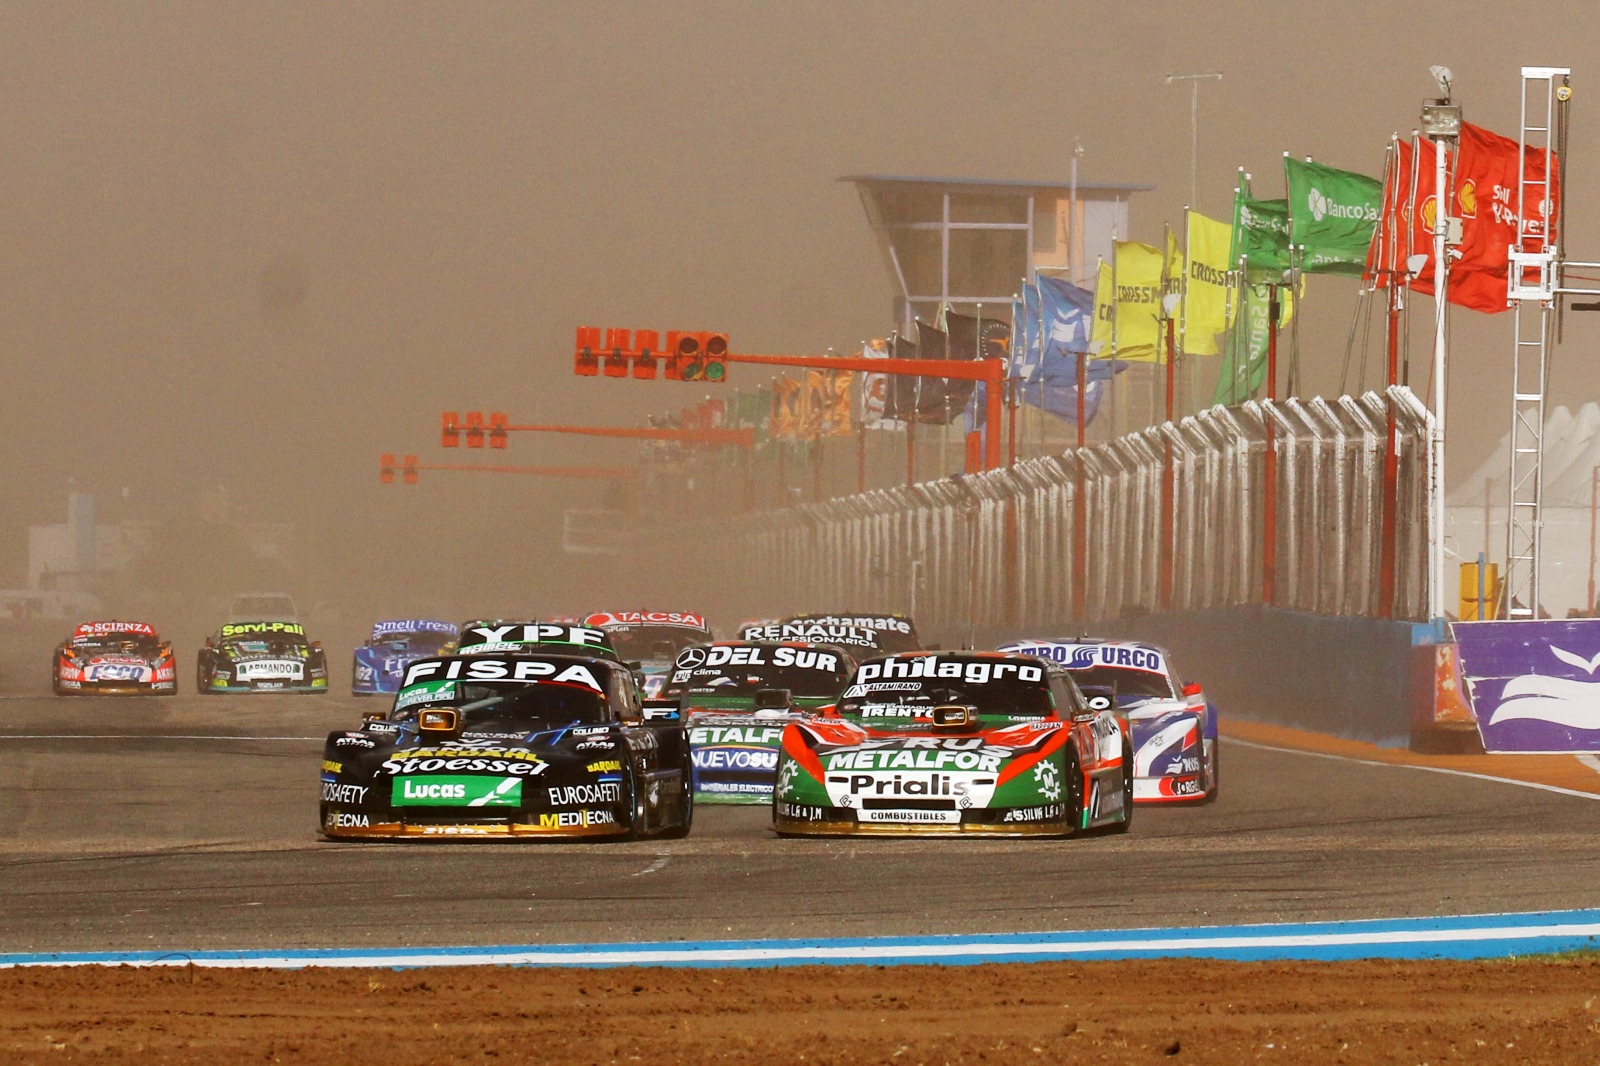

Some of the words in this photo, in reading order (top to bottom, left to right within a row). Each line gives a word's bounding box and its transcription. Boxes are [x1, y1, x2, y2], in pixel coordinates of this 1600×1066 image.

[619, 612, 700, 625] TACSA
[95, 622, 152, 633] SCIENZA
[374, 620, 414, 633] Smell
[418, 620, 457, 635] Fresh
[471, 625, 605, 644] YPF
[745, 625, 878, 642] RENAULT
[706, 646, 766, 667] DEL
[772, 647, 838, 673] SUR
[1102, 647, 1160, 670] URCO
[249, 663, 292, 674] ARMANDO
[404, 660, 603, 693] FISPA
[857, 656, 1042, 684] philagro
[399, 687, 429, 701] Lucas
[868, 682, 921, 691] ALTAMIRANO
[686, 727, 784, 744] ETALF
[391, 750, 545, 763] BARDAHL
[690, 751, 778, 768] NUEVOSU
[828, 750, 1002, 773] METALFOR
[382, 756, 549, 775] Stoessel
[404, 780, 465, 799] Lucas
[850, 774, 970, 796] Prialis
[548, 783, 622, 807] EUROSAFETY
[871, 811, 946, 821] COMBUSTIBLES
